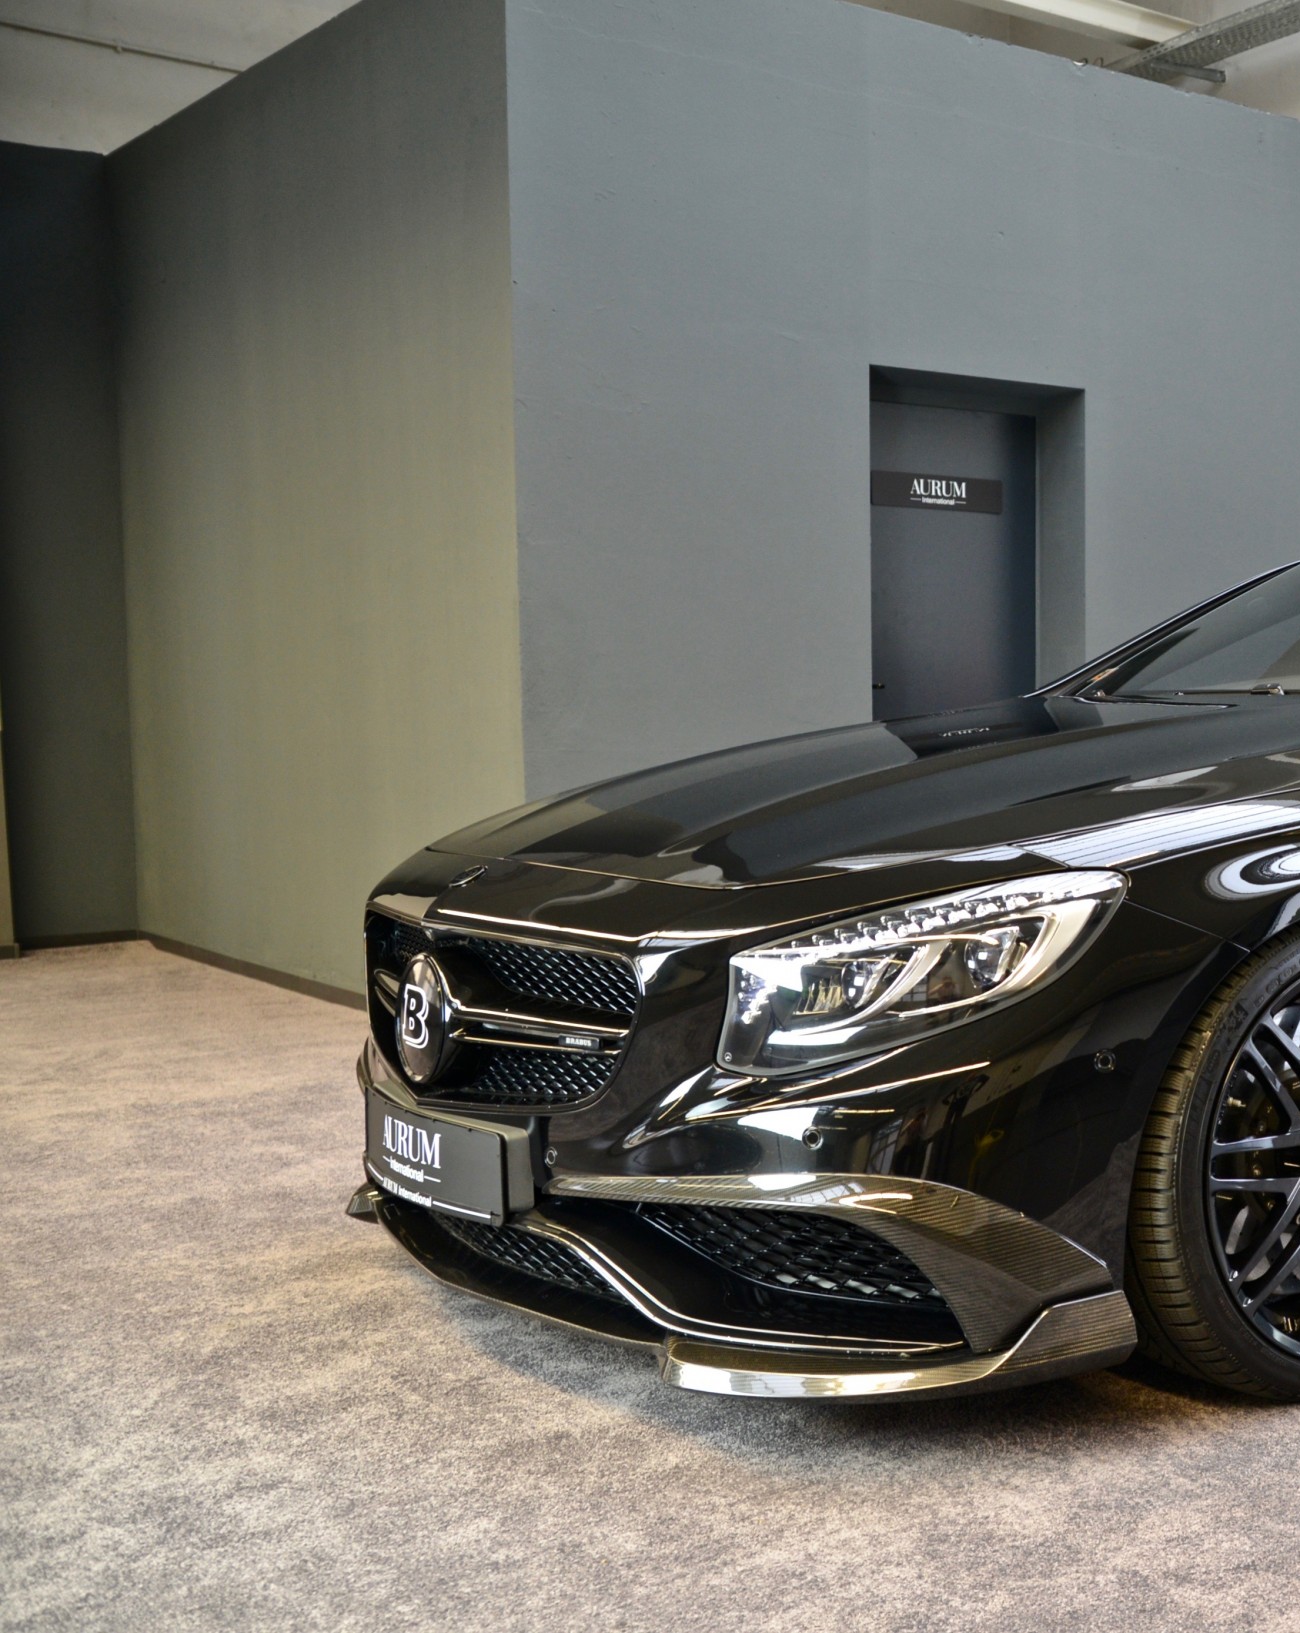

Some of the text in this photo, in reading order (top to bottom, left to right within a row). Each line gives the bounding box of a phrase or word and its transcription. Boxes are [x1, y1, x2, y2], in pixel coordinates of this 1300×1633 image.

[910, 478, 966, 498] AURUM
[922, 497, 956, 506] International
[402, 983, 430, 1049] B
[565, 1037, 592, 1047] BRABUS
[382, 1114, 442, 1169] AURUM
[389, 1156, 424, 1183] International
[398, 1184, 432, 1207] International
